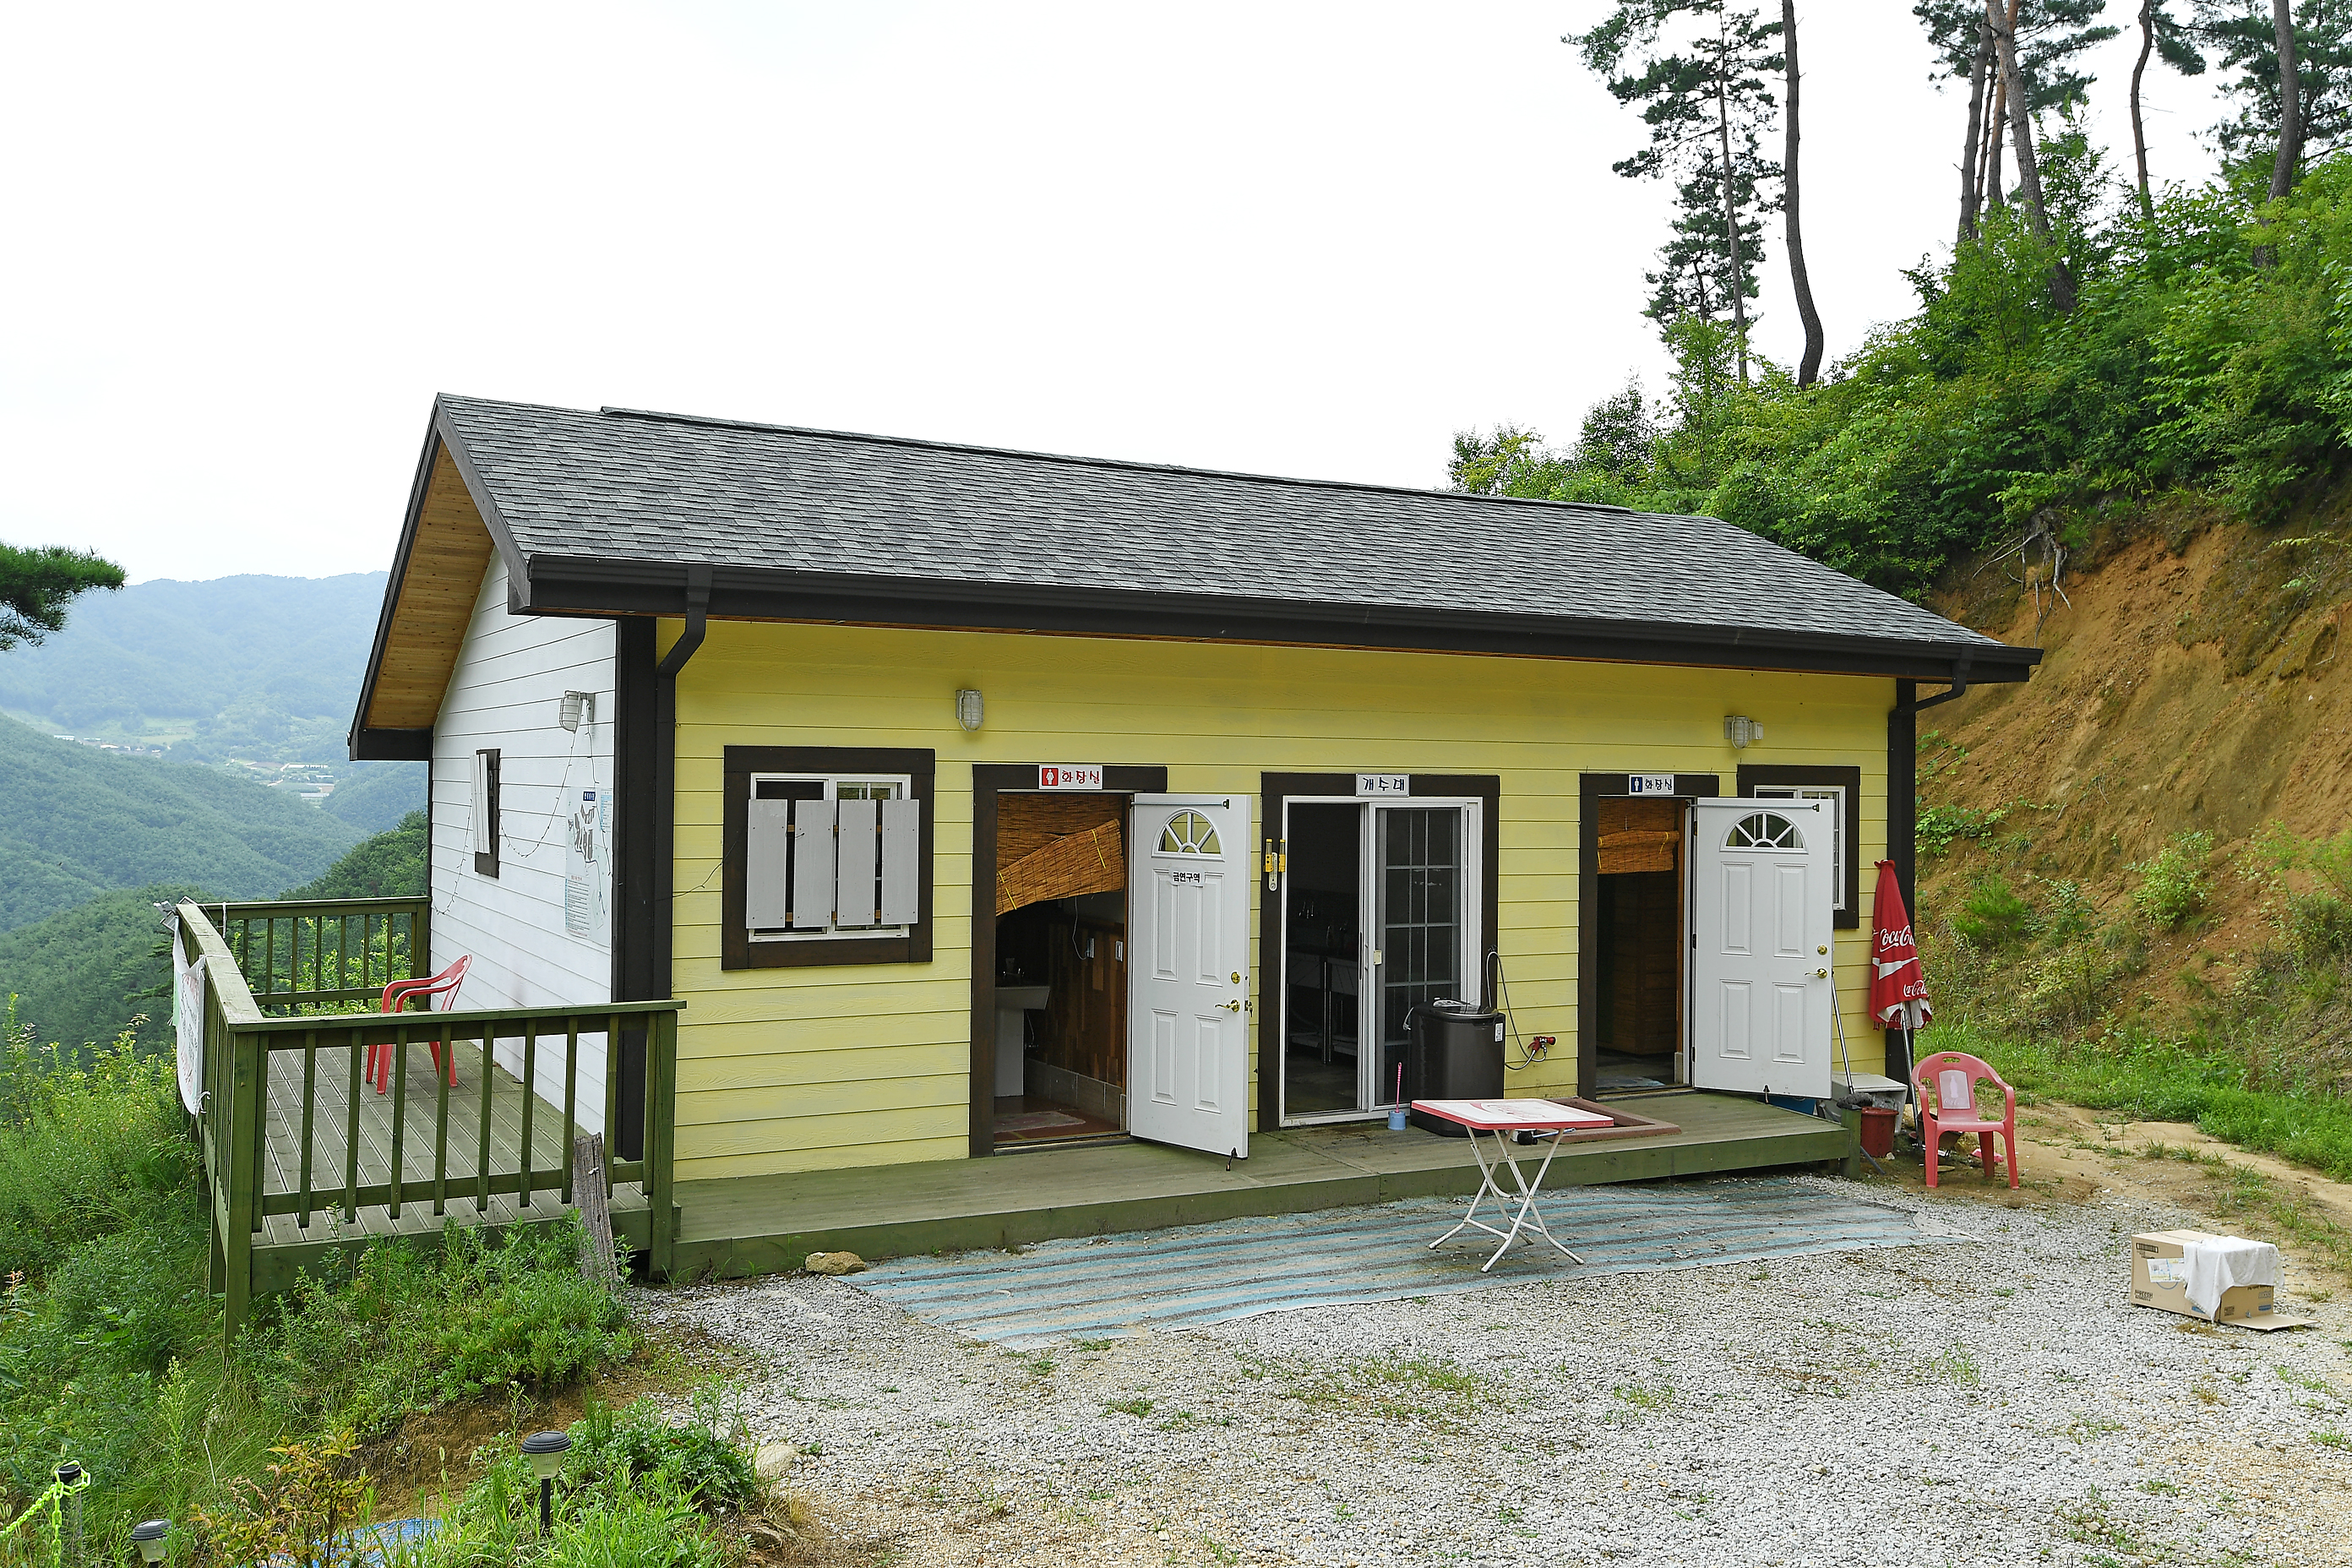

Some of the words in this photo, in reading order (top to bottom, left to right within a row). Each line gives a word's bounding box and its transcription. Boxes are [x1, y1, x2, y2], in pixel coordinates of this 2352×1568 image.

[1061, 770, 1100, 784] 화장실
[1362, 776, 1405, 792] 개수대
[1645, 778, 1673, 791] 화장실
[1173, 871, 1200, 884] 금연구역
[1879, 924, 1916, 953] Coca-Co
